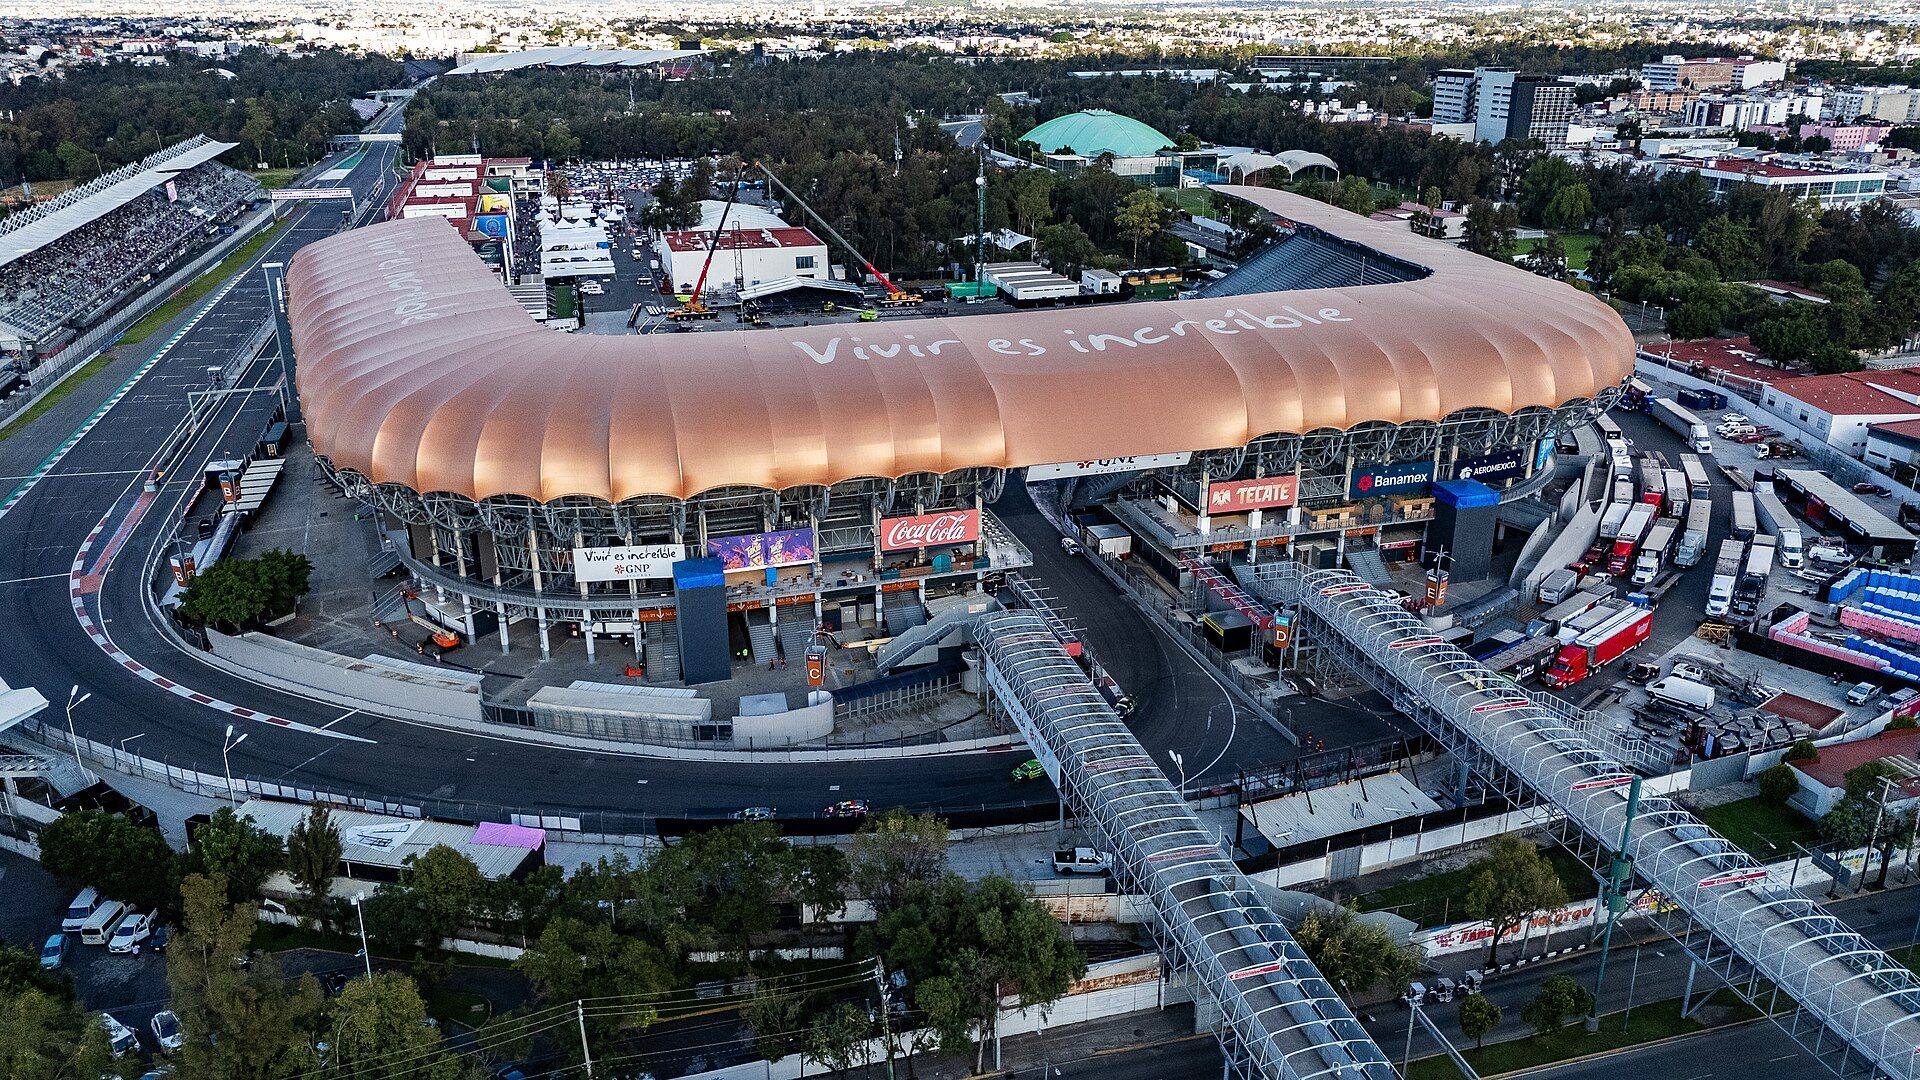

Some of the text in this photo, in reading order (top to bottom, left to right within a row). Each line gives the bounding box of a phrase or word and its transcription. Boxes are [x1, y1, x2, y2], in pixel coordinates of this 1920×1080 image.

[792, 305, 1353, 364] Vivir es increíble
[1473, 461, 1516, 476] AEROMEXICO
[1374, 472, 1428, 488] Banamex
[1236, 483, 1291, 505] TECATE
[888, 514, 969, 547] Coca-Cola
[584, 547, 676, 562] Vivir es increíble
[626, 564, 650, 574] GNP
[1427, 587, 1436, 599] E
[1276, 630, 1287, 642] D
[809, 668, 820, 679] C
